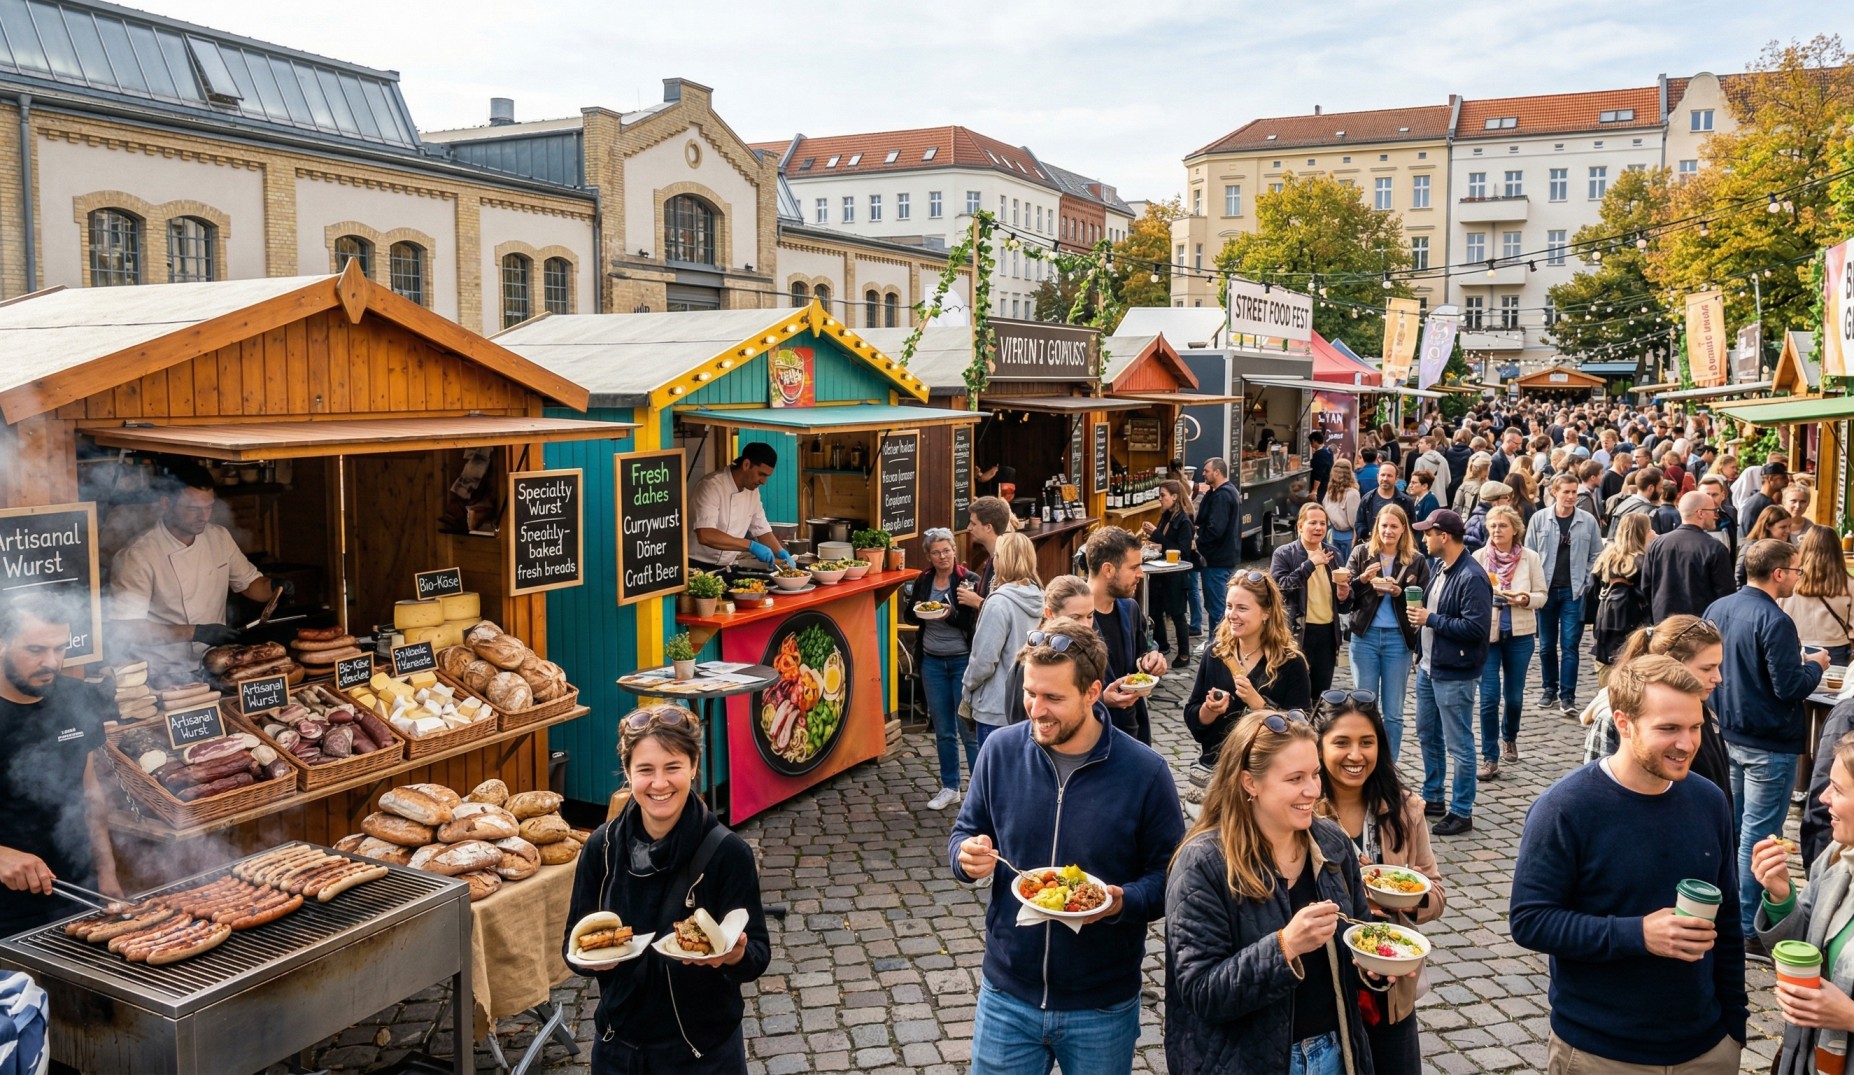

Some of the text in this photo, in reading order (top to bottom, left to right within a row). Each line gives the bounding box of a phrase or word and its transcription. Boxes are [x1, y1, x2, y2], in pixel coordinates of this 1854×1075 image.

[1236, 294, 1310, 330] STREET FOOD FEST
[632, 461, 669, 486] Fresh
[518, 481, 572, 504] Specialty
[529, 499, 562, 516] Wurst
[623, 508, 680, 537] Currywurst
[530, 542, 563, 558] baked
[637, 540, 667, 559] Döner
[3, 551, 64, 578] Wurst
[518, 558, 576, 580] fresh breads
[625, 563, 679, 588] Craft Beer
[243, 679, 283, 696] Artisanal
[248, 692, 280, 708] Wurst
[171, 710, 213, 729] Artisanal
[180, 723, 209, 739] Wurst
